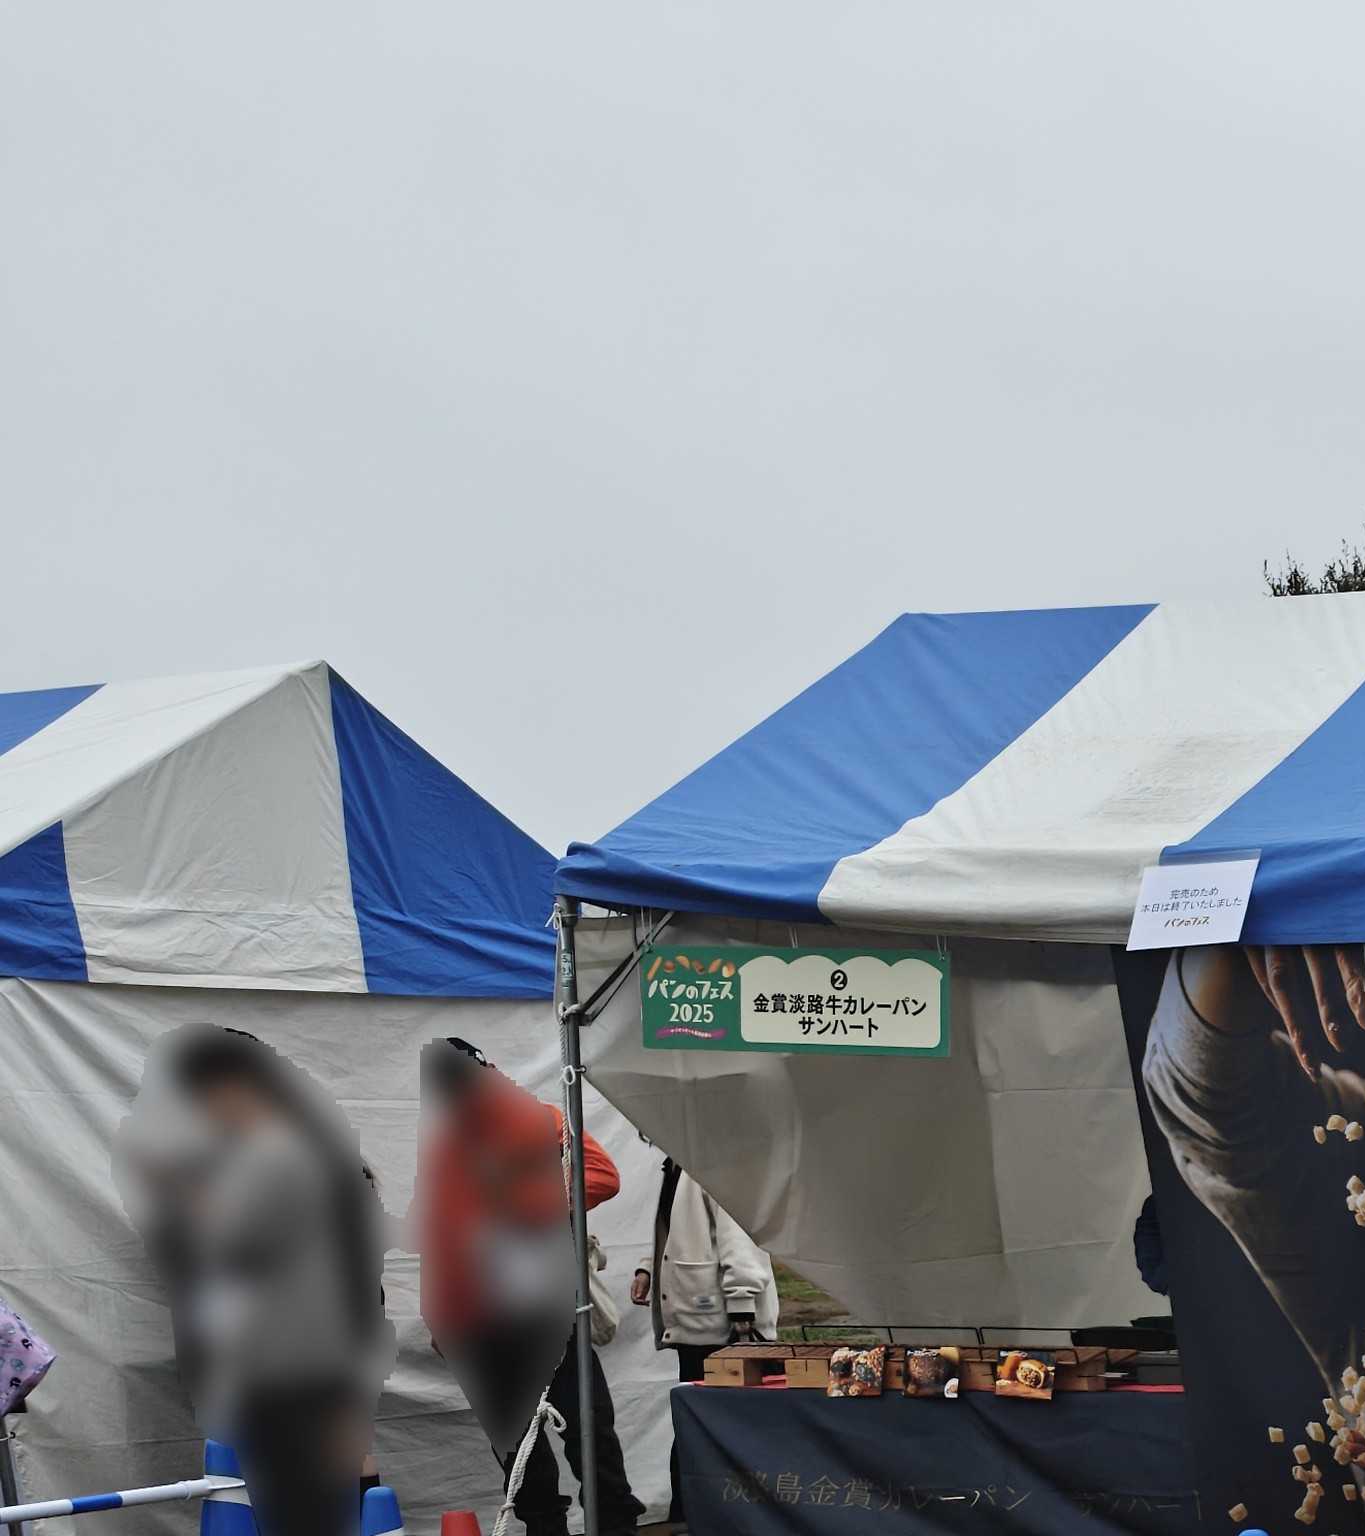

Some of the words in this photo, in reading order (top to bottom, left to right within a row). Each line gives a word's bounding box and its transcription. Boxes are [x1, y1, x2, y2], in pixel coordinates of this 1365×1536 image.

[1170, 888, 1218, 900] 完売のため
[648, 979, 734, 999] パンのフェス
[670, 1003, 714, 1023] 2025
[753, 993, 927, 1016] 金賞淡路牛カレーパン
[798, 1017, 879, 1038] サンハート
